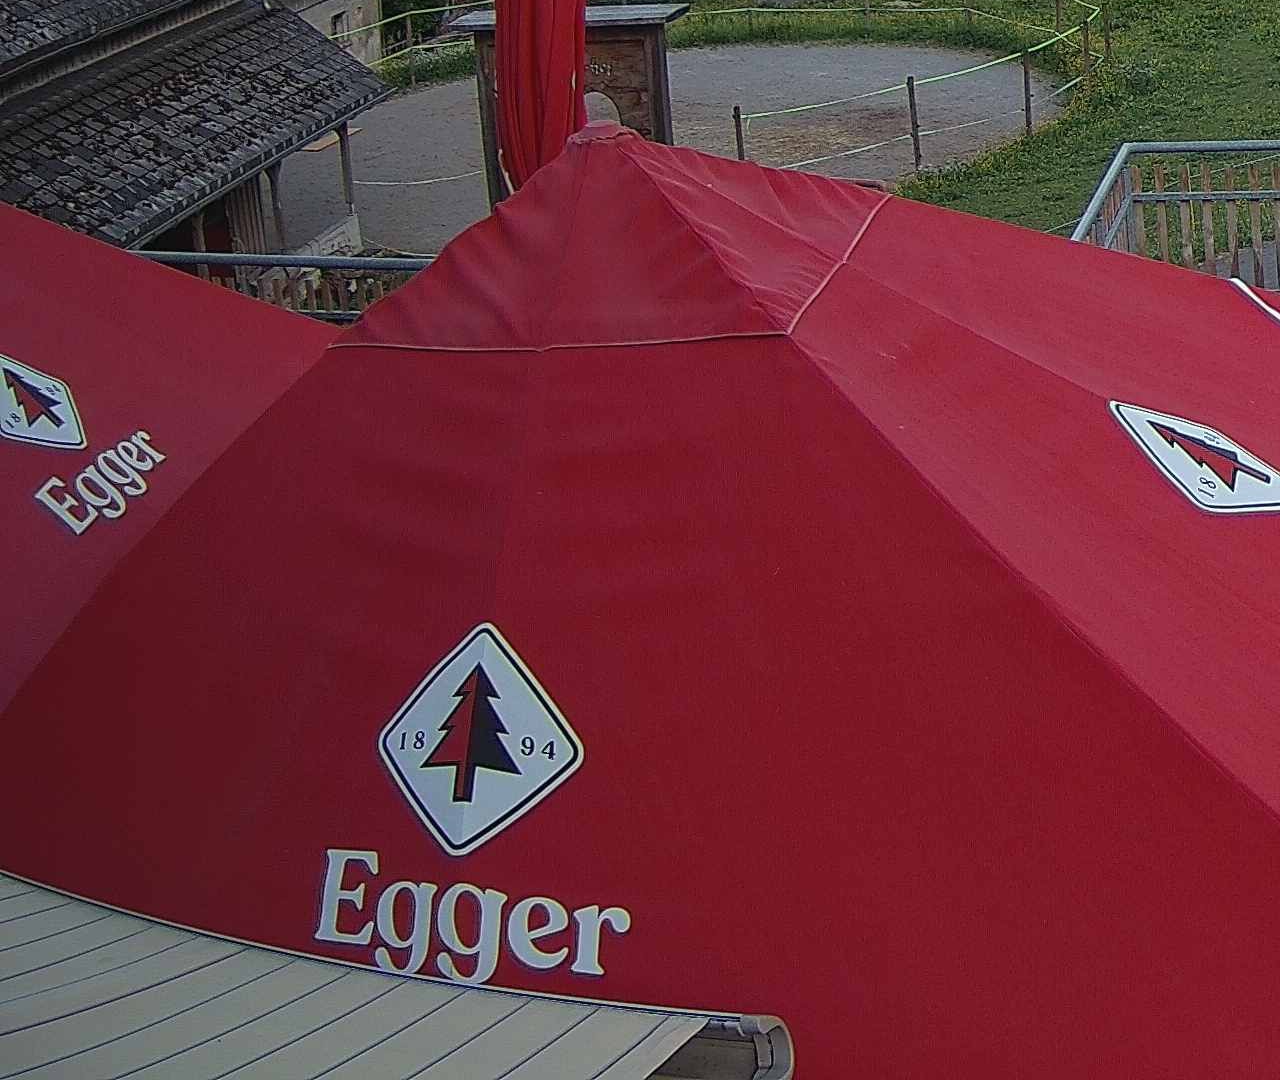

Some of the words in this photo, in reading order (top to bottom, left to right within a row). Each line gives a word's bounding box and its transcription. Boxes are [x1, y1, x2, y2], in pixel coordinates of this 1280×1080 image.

[34, 430, 167, 535] Egger
[1198, 477, 1216, 498] 18
[397, 730, 426, 751] 18
[520, 735, 557, 760] 94
[314, 849, 631, 984] Egger
